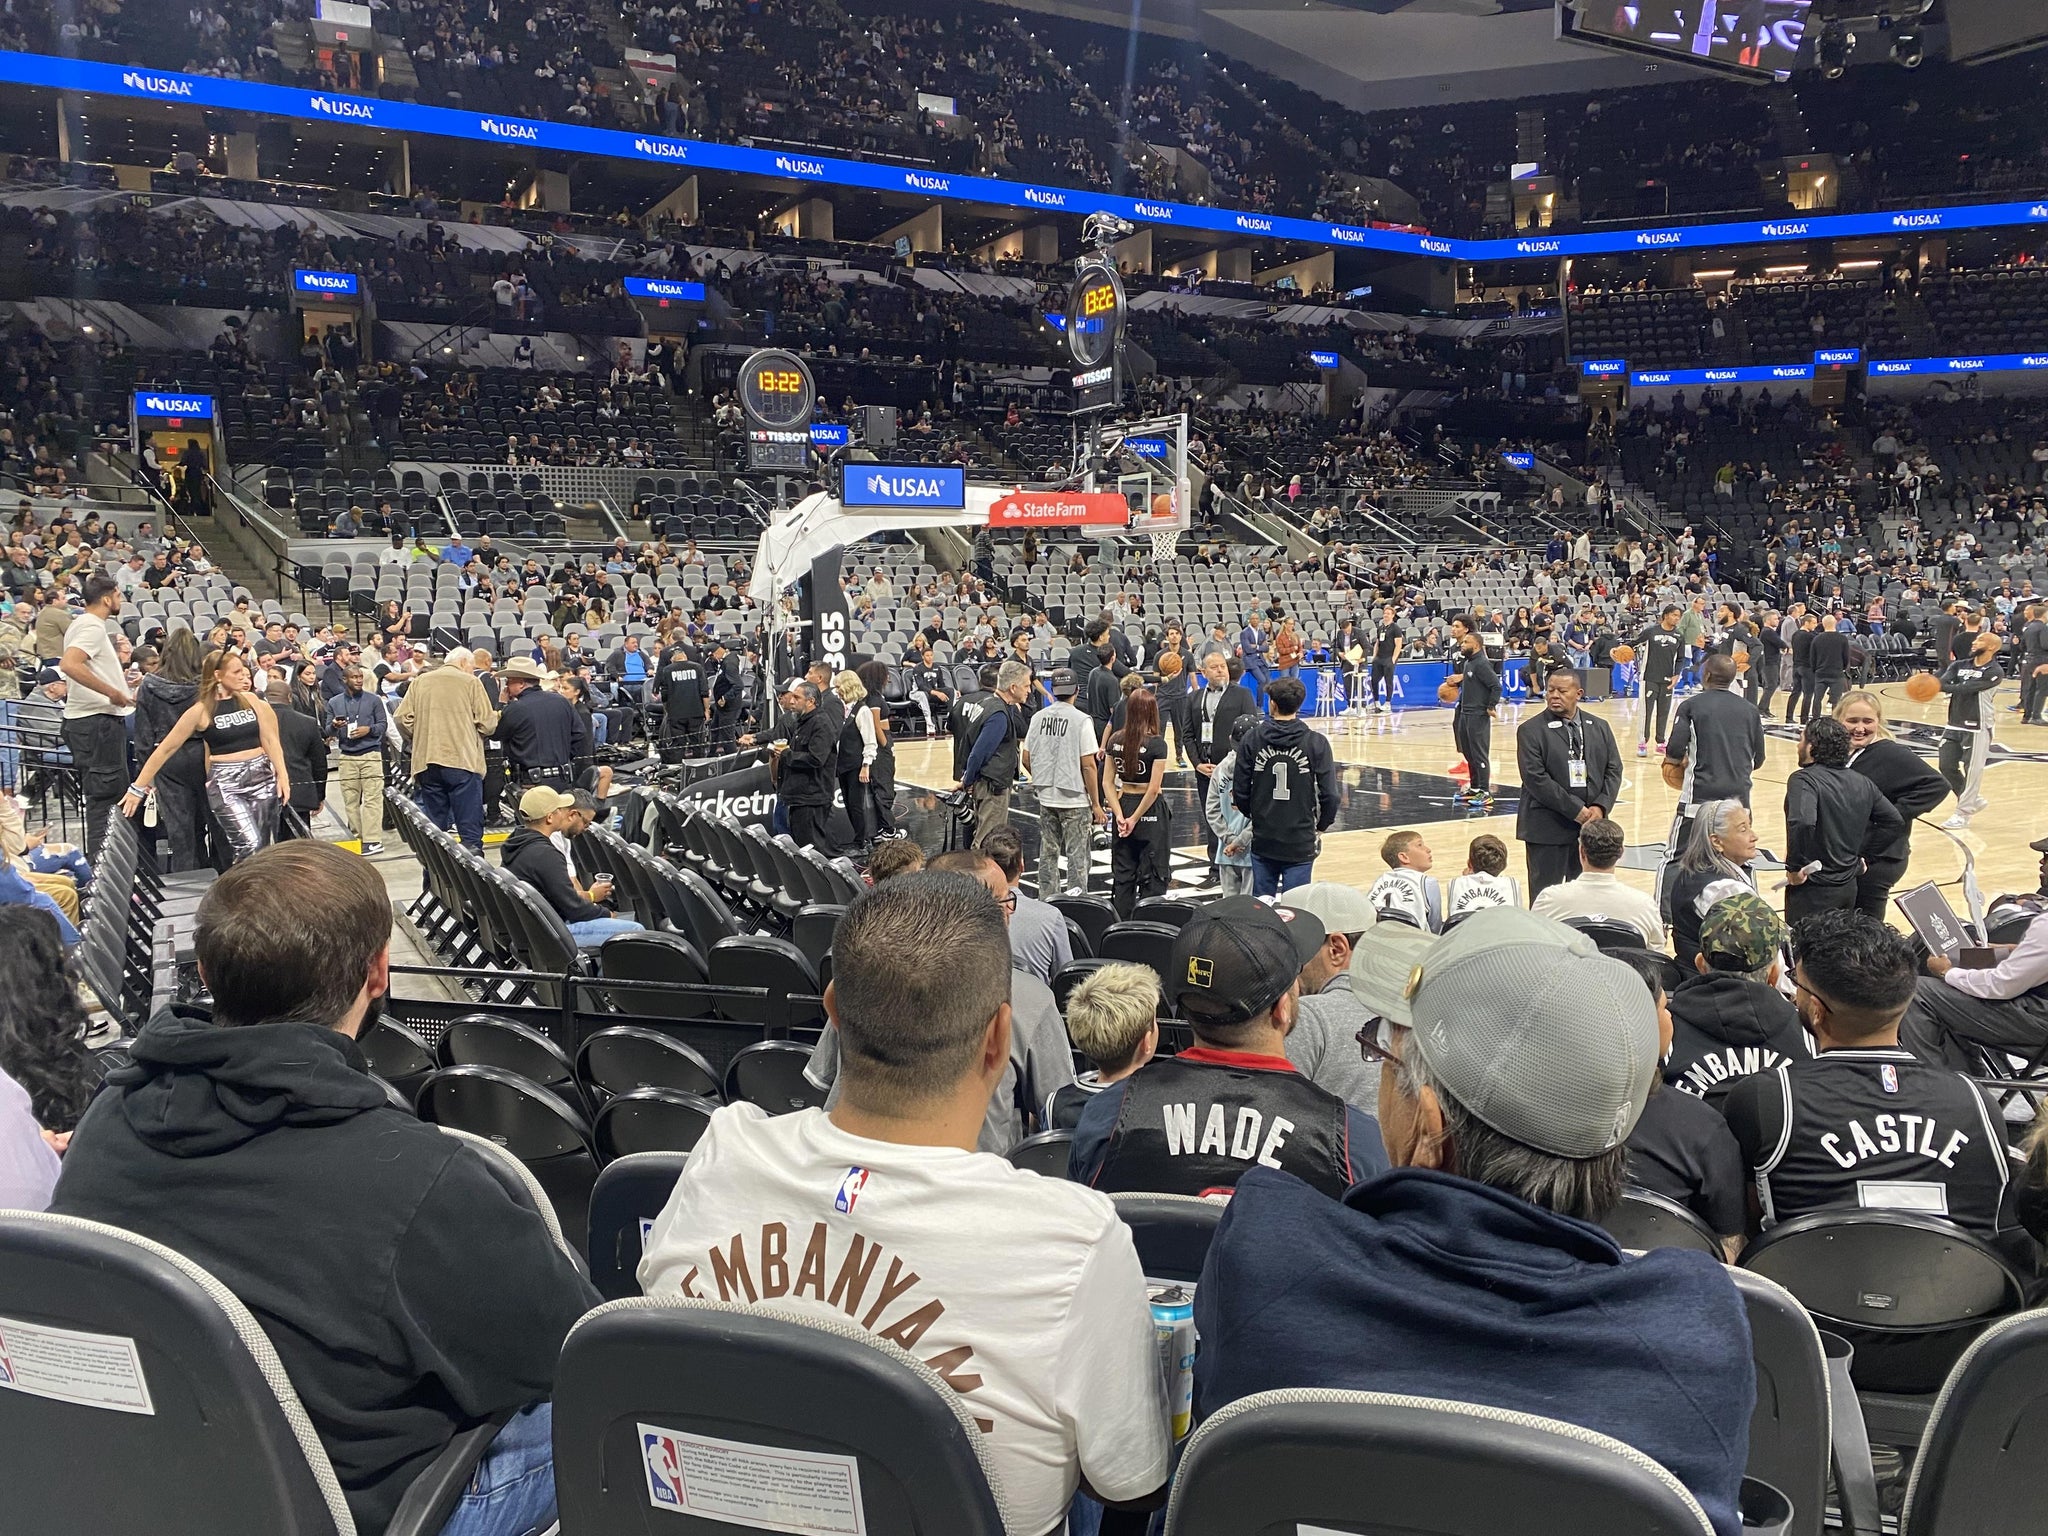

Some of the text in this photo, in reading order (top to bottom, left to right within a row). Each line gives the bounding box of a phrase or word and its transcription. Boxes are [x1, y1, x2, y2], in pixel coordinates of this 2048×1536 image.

[146, 77, 192, 96] USAA
[332, 101, 373, 119] USAA
[500, 123, 536, 140] USAA
[652, 143, 686, 158] USAA
[792, 160, 823, 176] USAA
[920, 176, 948, 191] USAA
[1038, 192, 1064, 205] USAA
[1148, 206, 1172, 218] USAA
[1248, 218, 1271, 230] USAA
[1909, 214, 1940, 226] USAA
[1778, 224, 1807, 235] USAA
[1343, 231, 1364, 242] USAA
[1652, 233, 1680, 244] USAA
[1430, 242, 1450, 252] USAA
[1532, 241, 1558, 252] USAA
[319, 277, 348, 288] USAA
[658, 284, 682, 294] USAA
[1961, 360, 1983, 368] USAA
[759, 372, 800, 392] 13:22
[1084, 367, 1112, 385] TISSOT
[1716, 372, 1736, 380] USAA
[165, 400, 201, 412] USAA
[766, 431, 808, 442] TISSOT
[814, 430, 840, 440] USAA
[893, 478, 940, 497] USAA
[672, 669, 697, 682] PHOTO
[214, 708, 256, 730] SPURS
[1040, 716, 1068, 738] PHOTO
[1272, 762, 1291, 800] 1
[1456, 888, 1506, 910] WEMBANYAM
[1163, 1103, 1295, 1170] WADE
[1820, 1114, 1970, 1168] CASTLE
[656, 1487, 673, 1500] NBA
